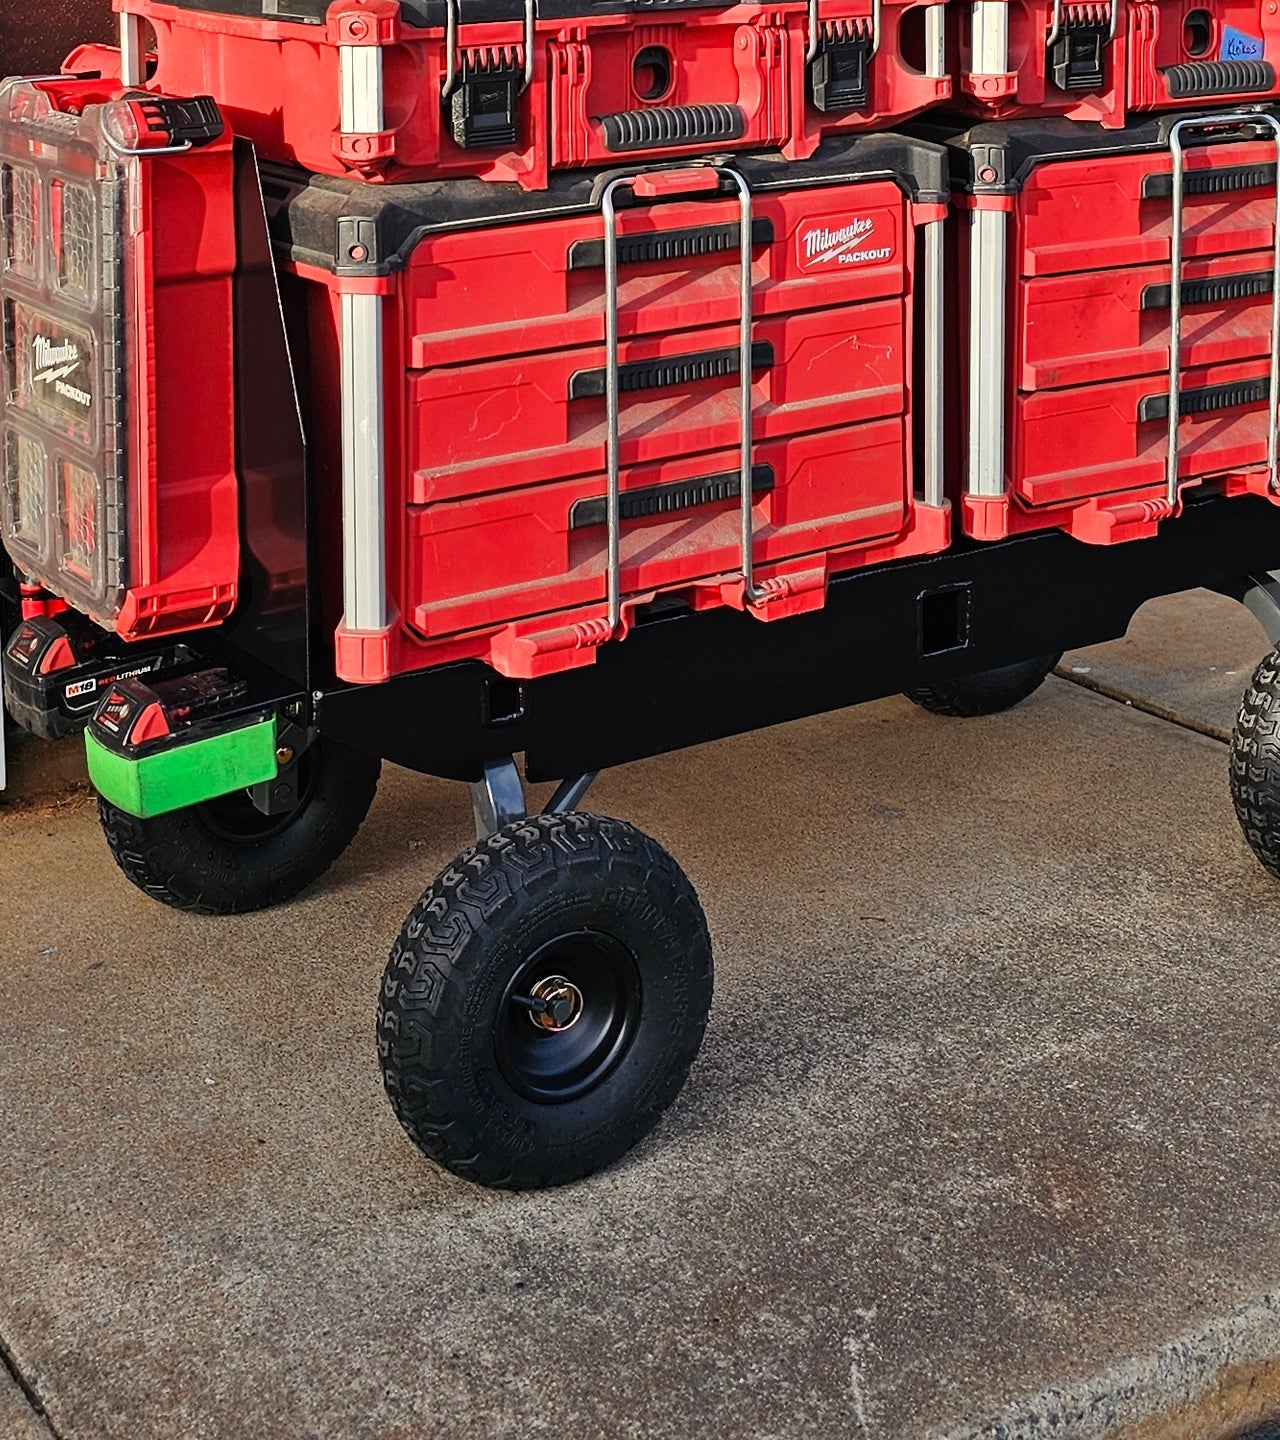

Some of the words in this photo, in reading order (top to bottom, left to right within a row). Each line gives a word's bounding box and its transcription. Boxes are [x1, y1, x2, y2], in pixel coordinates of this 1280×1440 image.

[802, 217, 873, 258] Milwaukee
[838, 247, 891, 264] PACKOUT
[32, 334, 79, 370] Milwaukee
[55, 379, 92, 407] PACKOUT
[67, 680, 95, 696] M18
